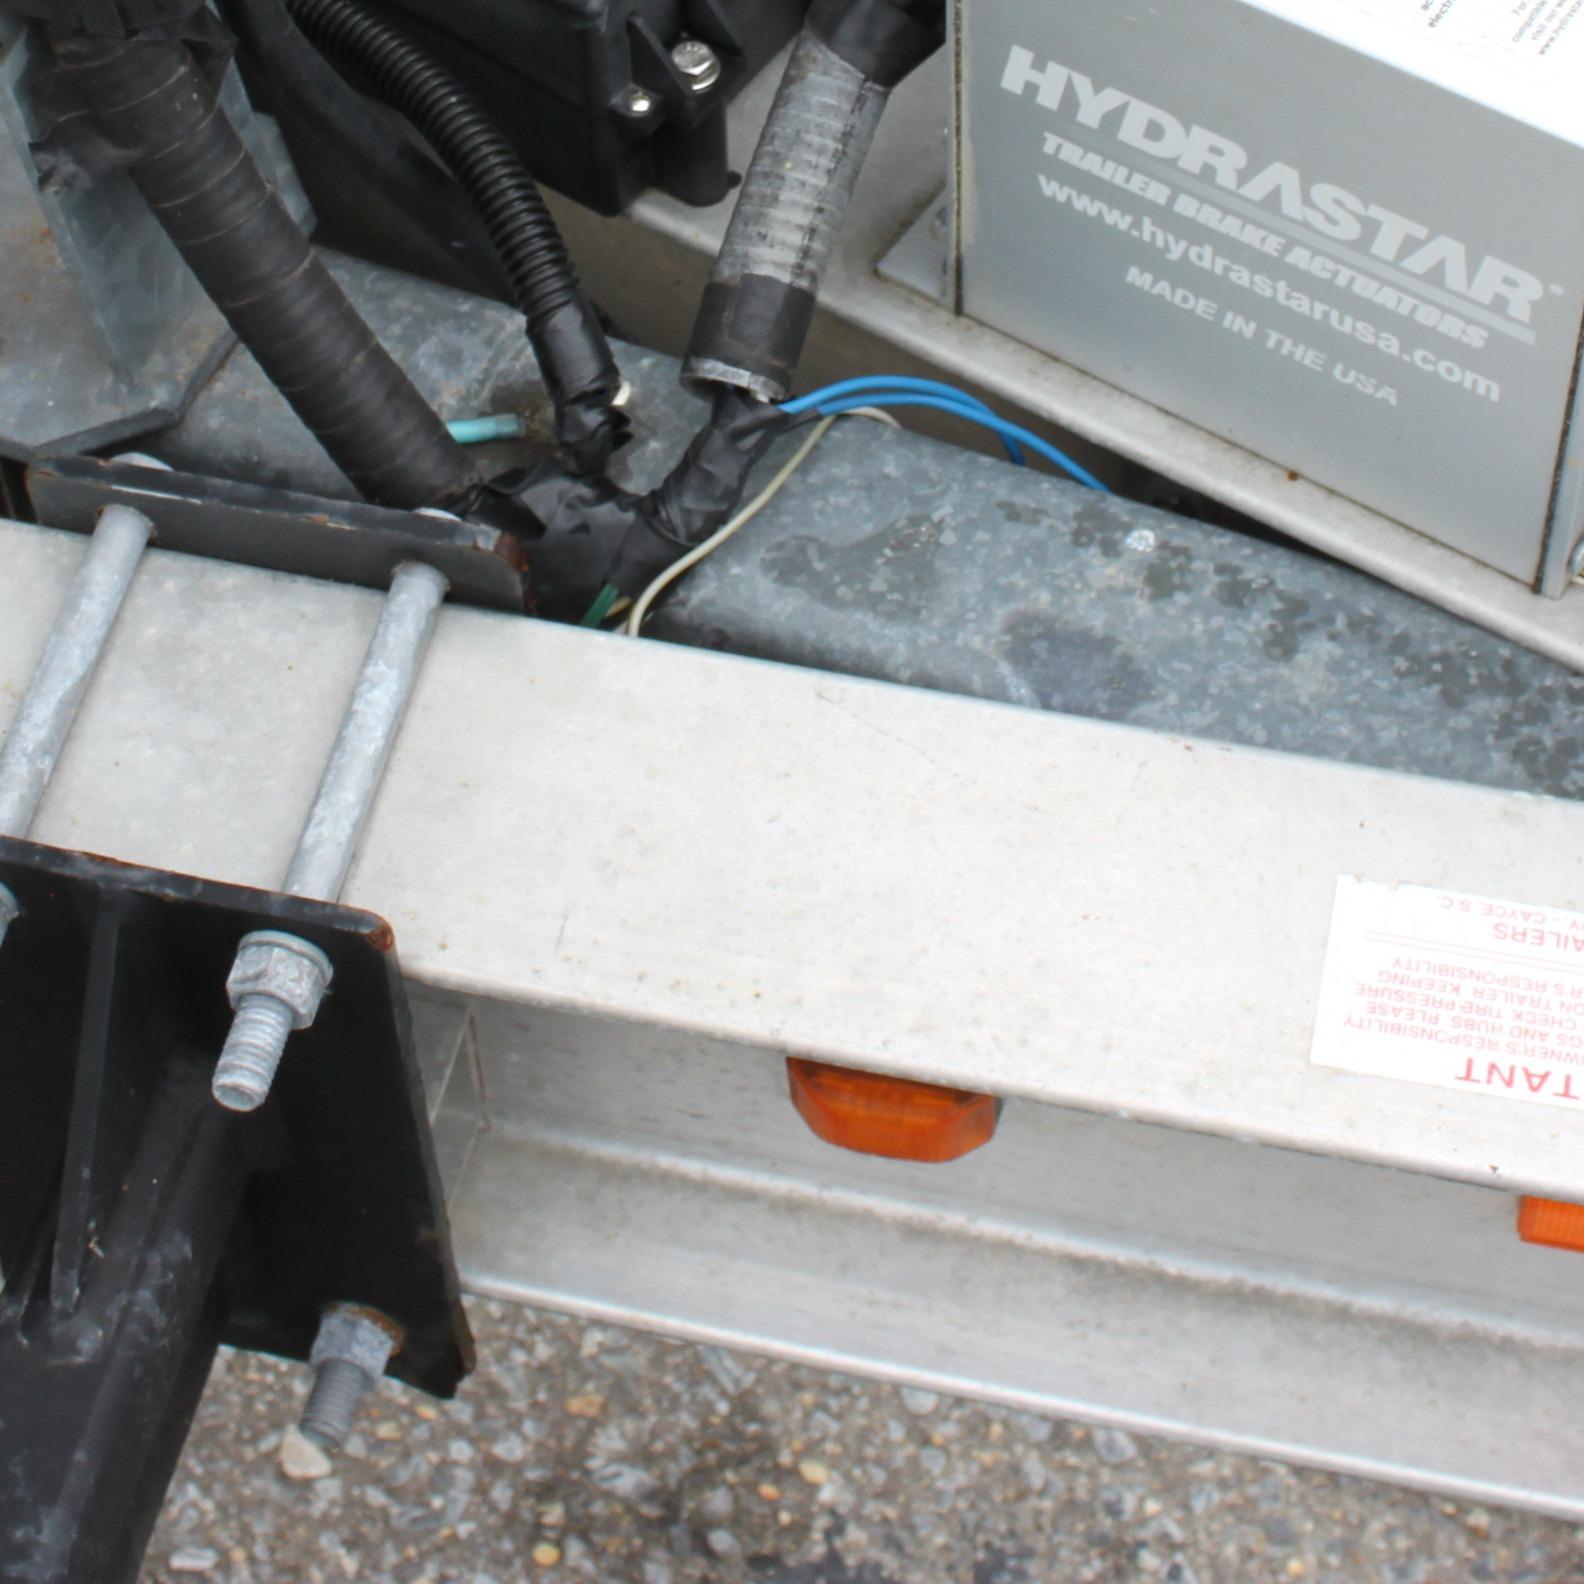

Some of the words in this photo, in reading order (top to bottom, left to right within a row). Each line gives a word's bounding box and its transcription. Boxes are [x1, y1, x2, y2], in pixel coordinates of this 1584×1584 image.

[1000, 44, 1545, 324] HYDRASTAR
[1041, 131, 1171, 207] TRAILER
[1173, 192, 1287, 259] BRAKE
[1287, 243, 1487, 350] ACTUATORS
[1036, 172, 1501, 403] www.hydrastarusa.com
[1126, 265, 1217, 322] MADE
[1223, 309, 1255, 340] IN
[1264, 329, 1325, 372] THE
[1332, 362, 1399, 406] USA
[1474, 900, 1546, 924] CAYCE,
[1351, 980, 1456, 1011] PRESSURE
[1375, 968, 1461, 995] KEEPING
[1363, 999, 1440, 1025] PLEASE
[1509, 1008, 1577, 1031] CHECK
[1342, 1013, 1500, 1052] RESPONSIBILITY
[1509, 1024, 1550, 1043] AND
